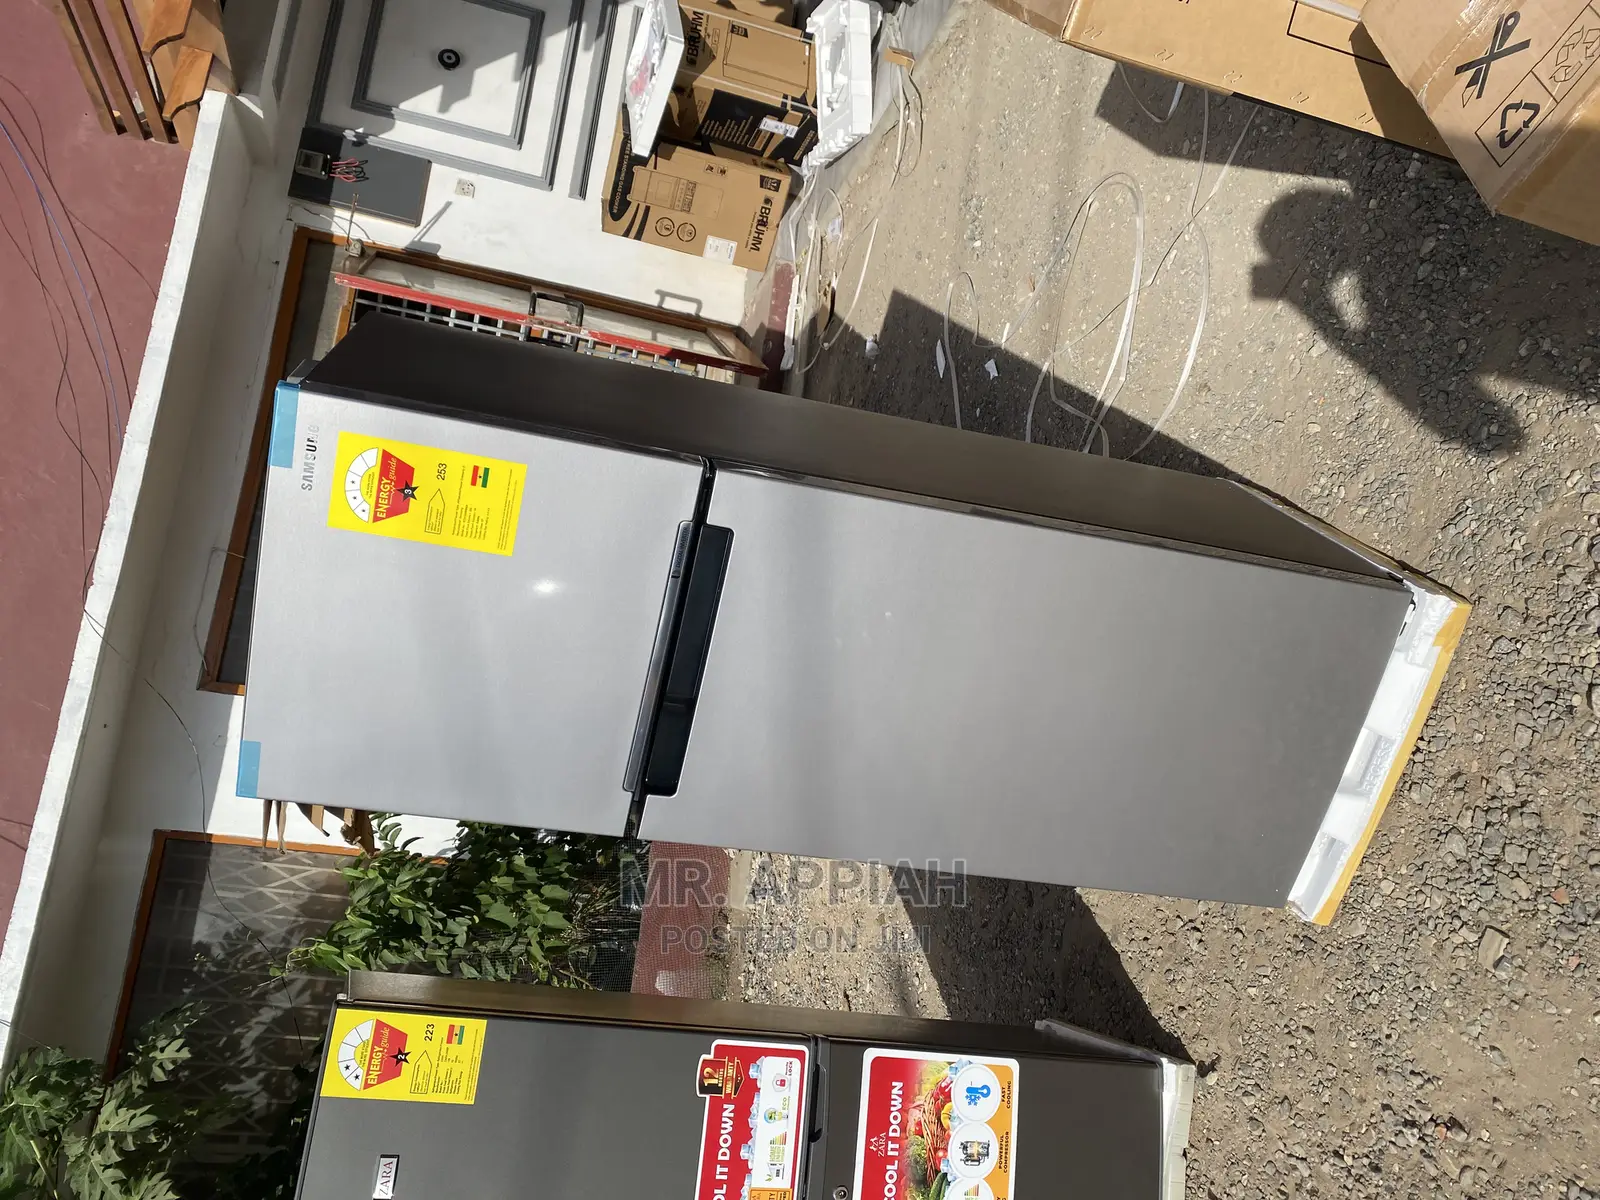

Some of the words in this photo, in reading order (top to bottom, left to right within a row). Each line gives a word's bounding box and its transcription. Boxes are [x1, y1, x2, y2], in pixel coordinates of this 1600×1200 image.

[619, 155, 630, 181] STANDING
[616, 181, 624, 192] GAS
[612, 192, 622, 214] COOKER
[300, 423, 320, 492] SAMSUNG
[436, 462, 447, 481] 253
[375, 477, 391, 519] ENERGY
[387, 458, 397, 481] guide
[424, 1023, 435, 1042] 223
[366, 1045, 384, 1085] ENERGY
[381, 1026, 390, 1048] guide
[702, 1067, 719, 1087] 12
[888, 1081, 904, 1138] DOWN
[717, 1104, 735, 1160] DOWN
[877, 1132, 886, 1157] ZARA
[887, 1140, 900, 1156] IT
[379, 1161, 394, 1196] ZARA
[715, 1164, 729, 1180] IT
[883, 1160, 899, 1200] OOL
